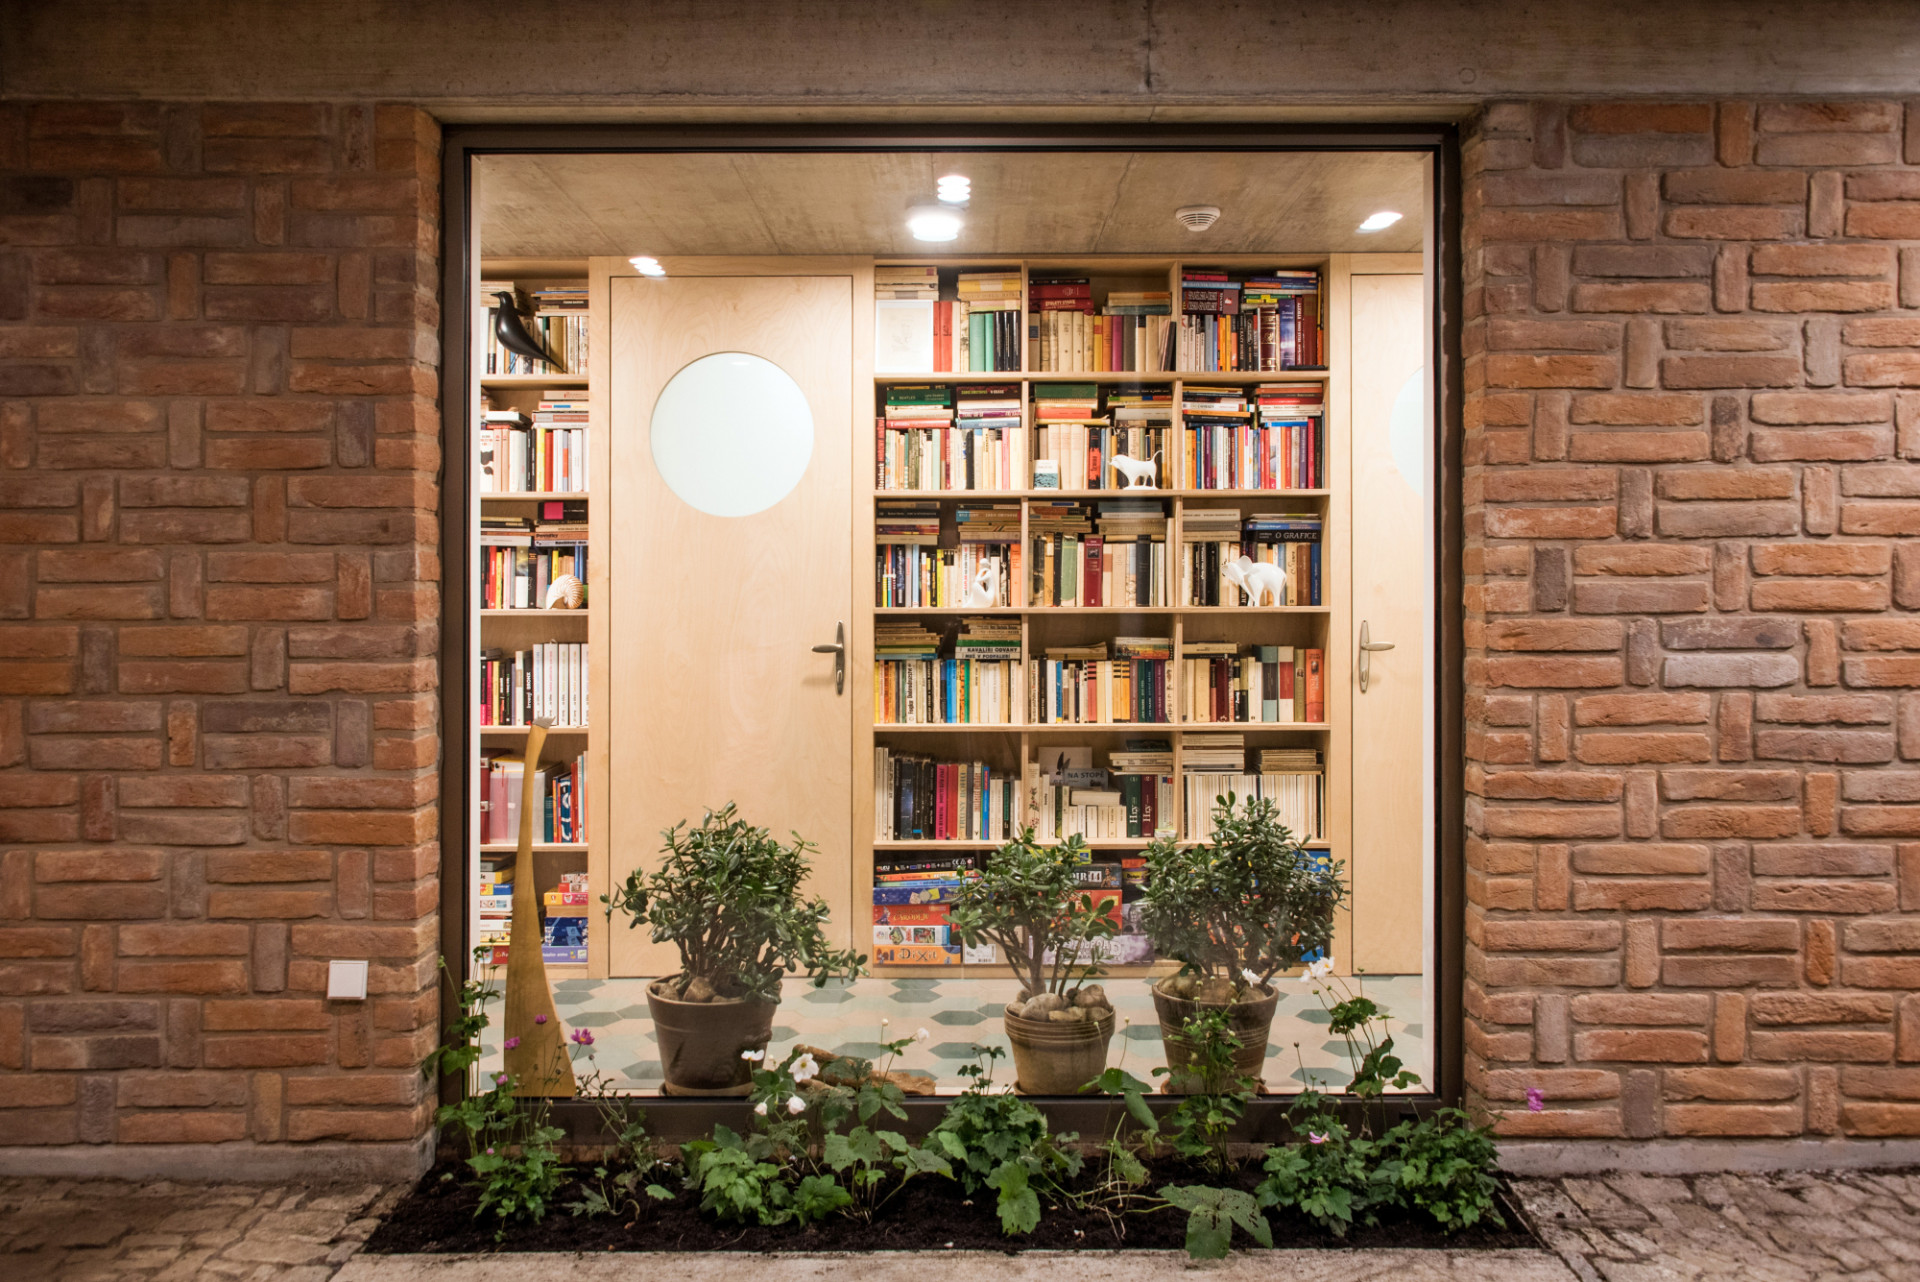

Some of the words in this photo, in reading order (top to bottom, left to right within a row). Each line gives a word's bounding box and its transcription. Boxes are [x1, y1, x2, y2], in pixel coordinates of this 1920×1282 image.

[877, 463, 885, 490] Steinbeck
[1081, 771, 1104, 779] STOPĚ
[1129, 804, 1139, 824] Hry
[1142, 804, 1153, 823] Hry
